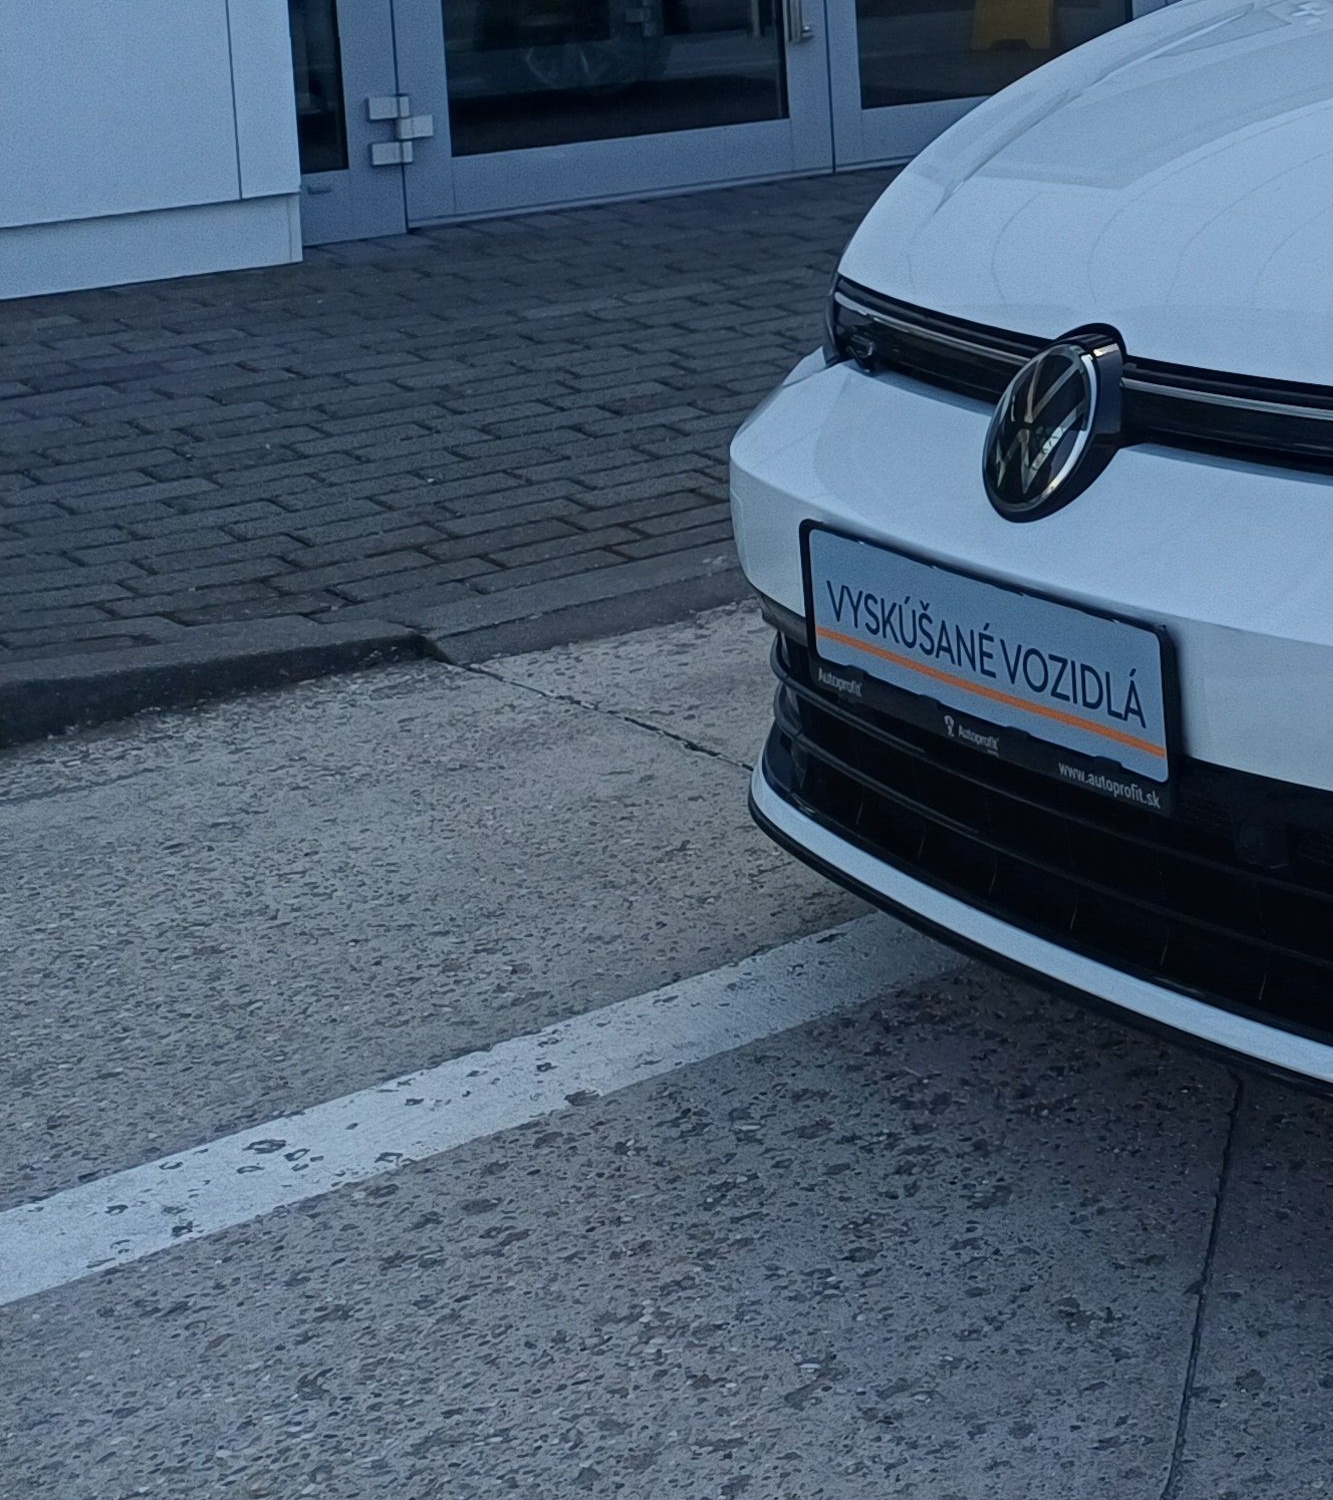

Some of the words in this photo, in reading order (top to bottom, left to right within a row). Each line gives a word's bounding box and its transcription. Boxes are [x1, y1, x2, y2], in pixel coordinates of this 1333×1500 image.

[826, 579, 997, 679] VYSKÚŠANÉ
[1000, 637, 1147, 729] VOZIDLÁ
[818, 667, 862, 697] Autoprofit
[1057, 762, 1162, 810] www.autoprofit.sk
